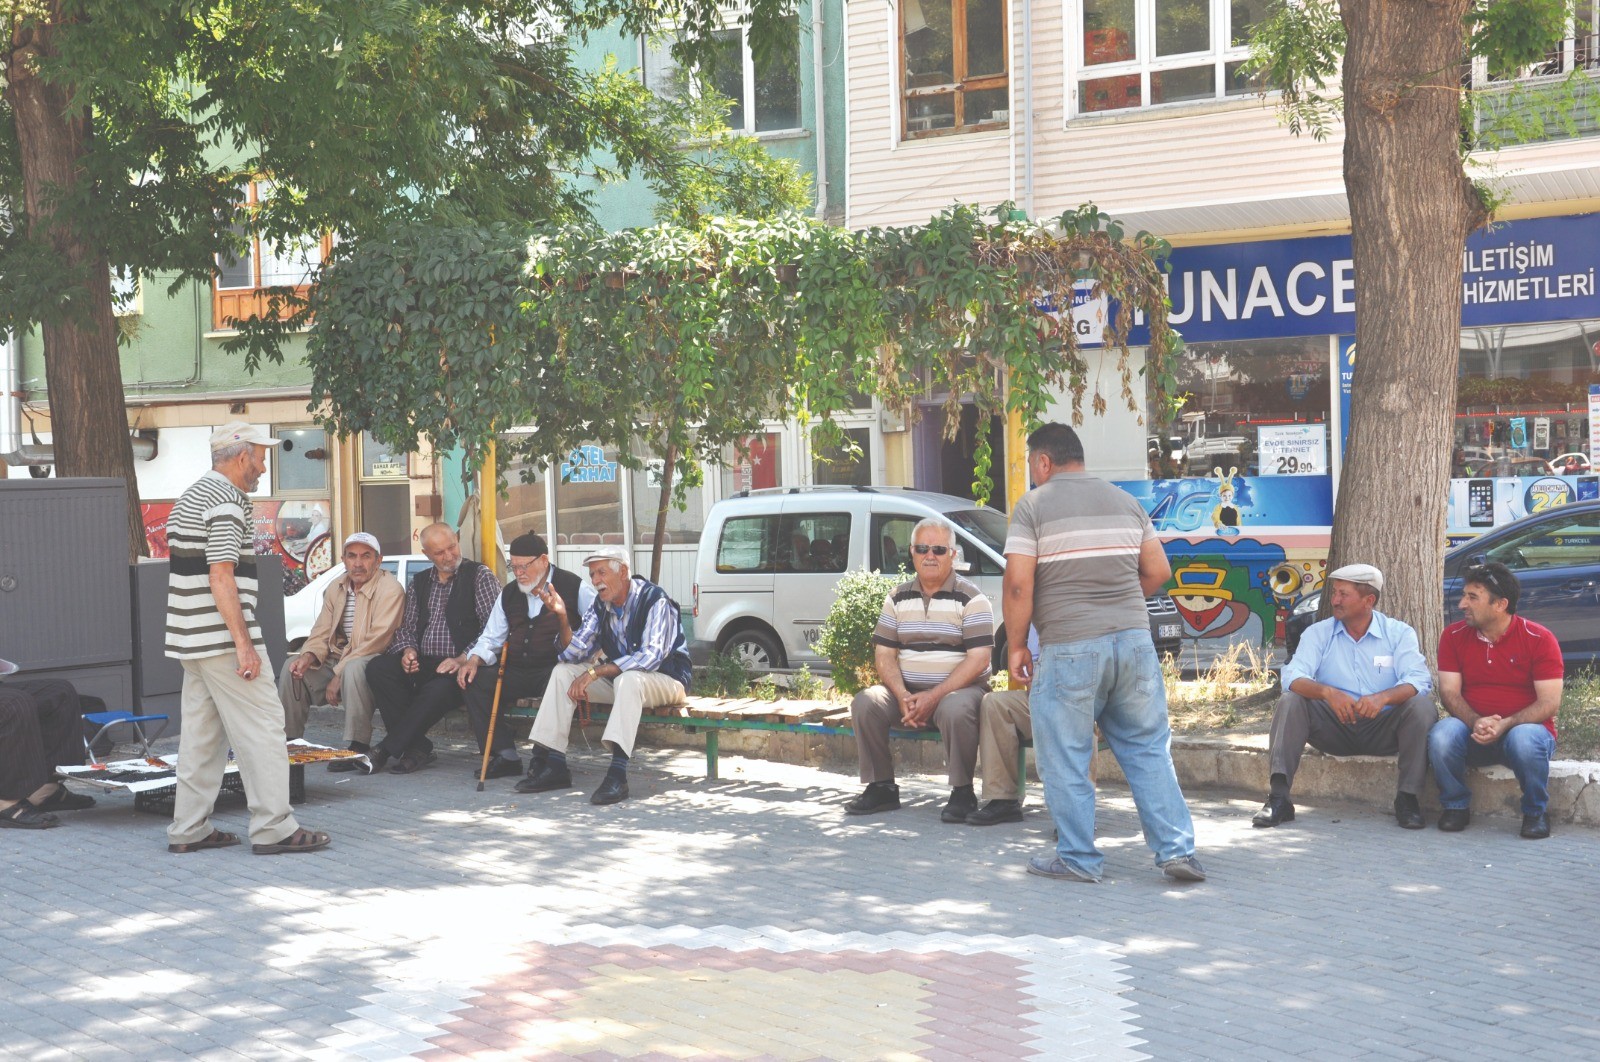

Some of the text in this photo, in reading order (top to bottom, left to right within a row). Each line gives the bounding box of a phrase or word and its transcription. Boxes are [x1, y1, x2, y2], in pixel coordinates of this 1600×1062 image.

[1463, 240, 1554, 274] İLETİŞİM
[1134, 259, 1356, 326] UNACE
[1463, 267, 1594, 304] HİZMETLERİ
[1036, 295, 1092, 307] SASNG
[568, 444, 607, 466] OTEL
[1276, 456, 1313, 474] 29.90
[561, 461, 617, 483] FERHAT
[1531, 491, 1567, 513] 24
